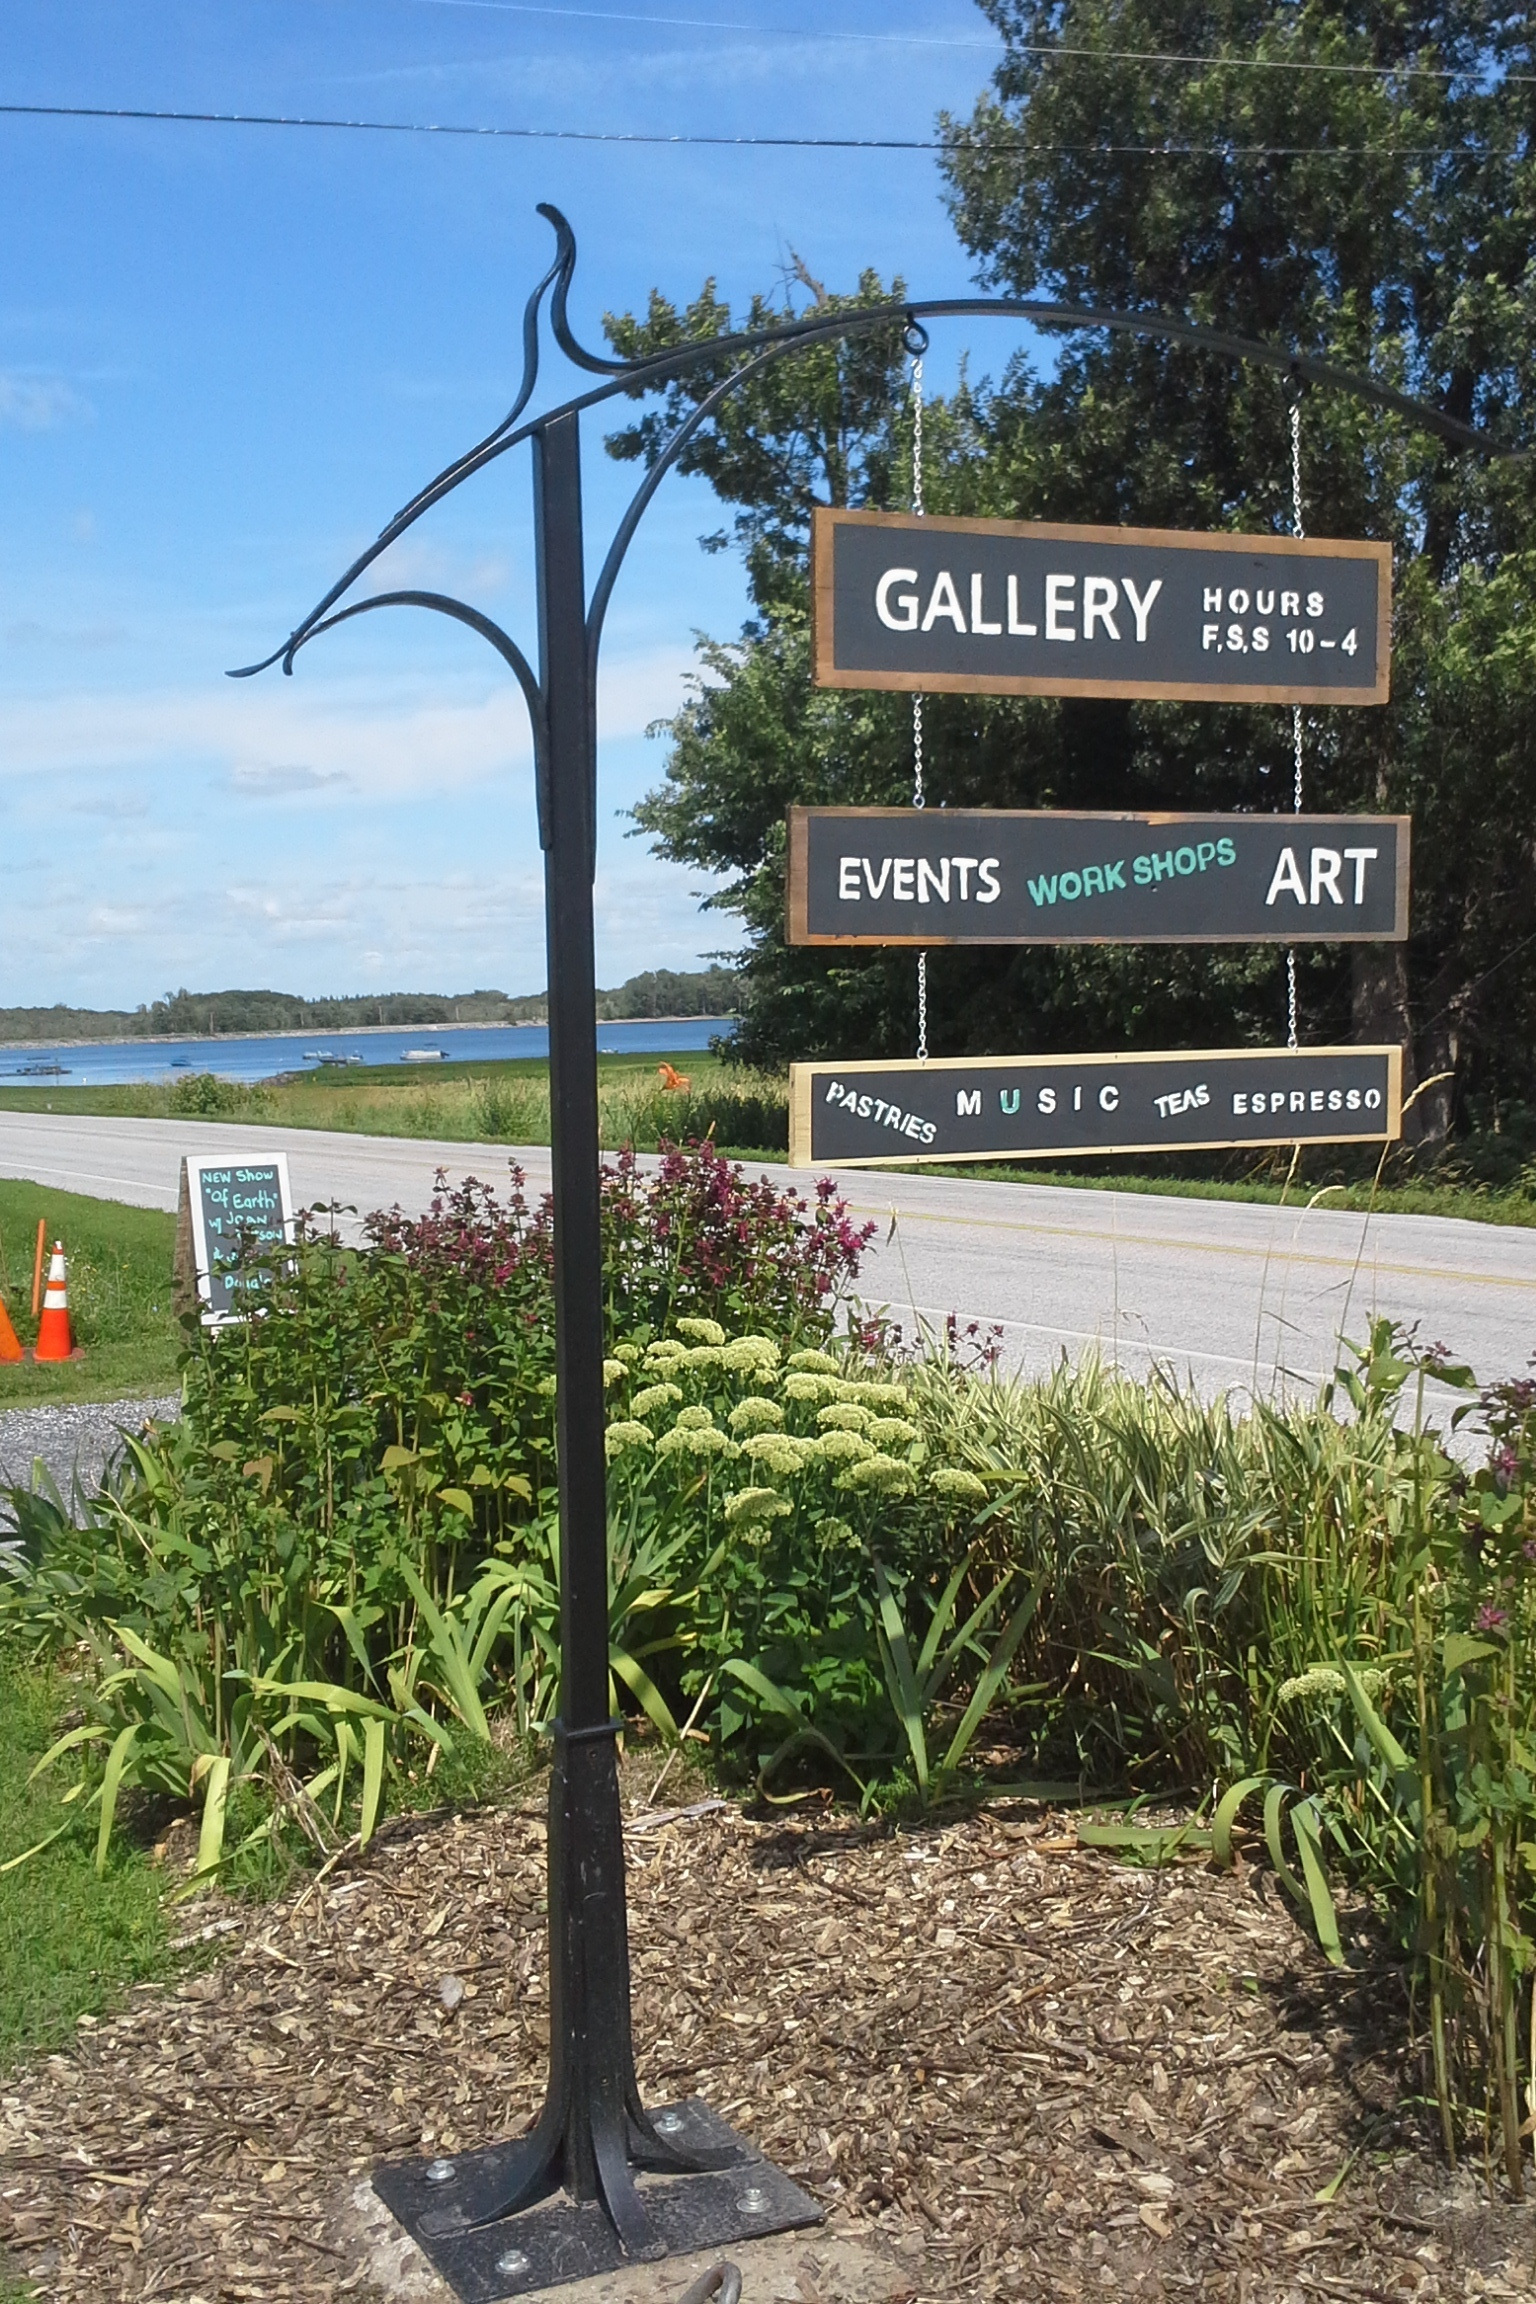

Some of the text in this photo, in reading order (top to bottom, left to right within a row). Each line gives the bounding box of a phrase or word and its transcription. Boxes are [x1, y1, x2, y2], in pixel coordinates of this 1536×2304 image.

[875, 568, 1163, 643] GALLERY
[1203, 587, 1325, 618] HOURS
[838, 837, 1378, 907] EVENTS WORK SHOPS ART
[825, 1081, 1381, 1144] PASTRIES MUSIC TEAS ESPRESSO
[202, 1169, 273, 1183] NEW Show
